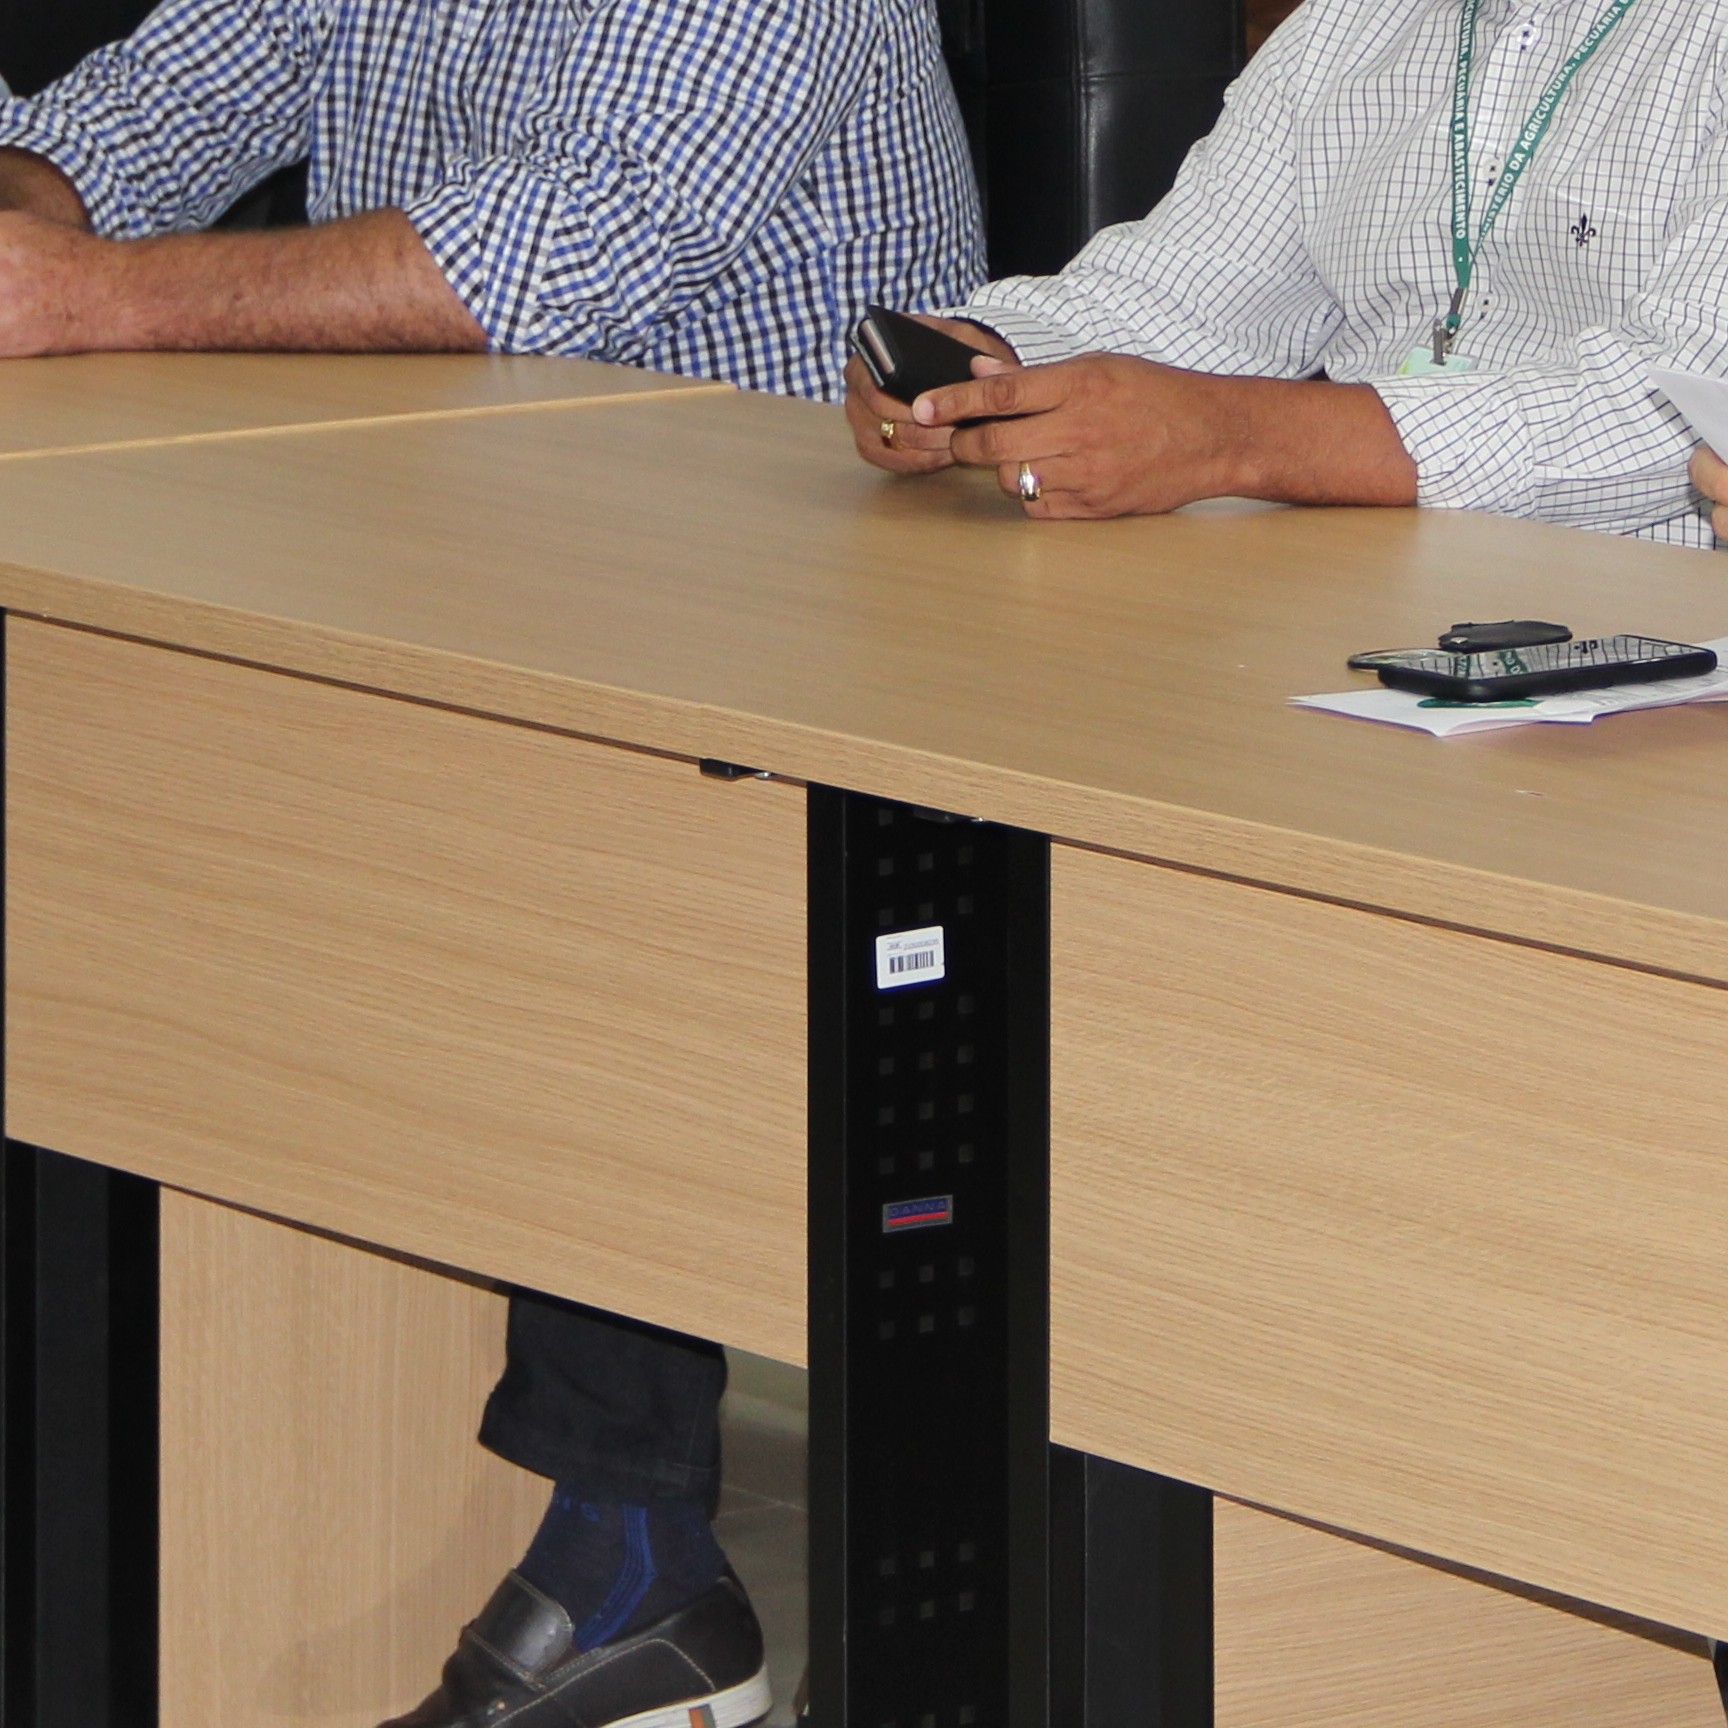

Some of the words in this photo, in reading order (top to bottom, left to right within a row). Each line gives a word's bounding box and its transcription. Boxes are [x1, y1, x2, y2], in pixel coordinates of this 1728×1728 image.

[1455, 122, 1465, 131] E
[1509, 152, 1526, 171] DA
[1454, 134, 1466, 239] ABASTECIMENTO
